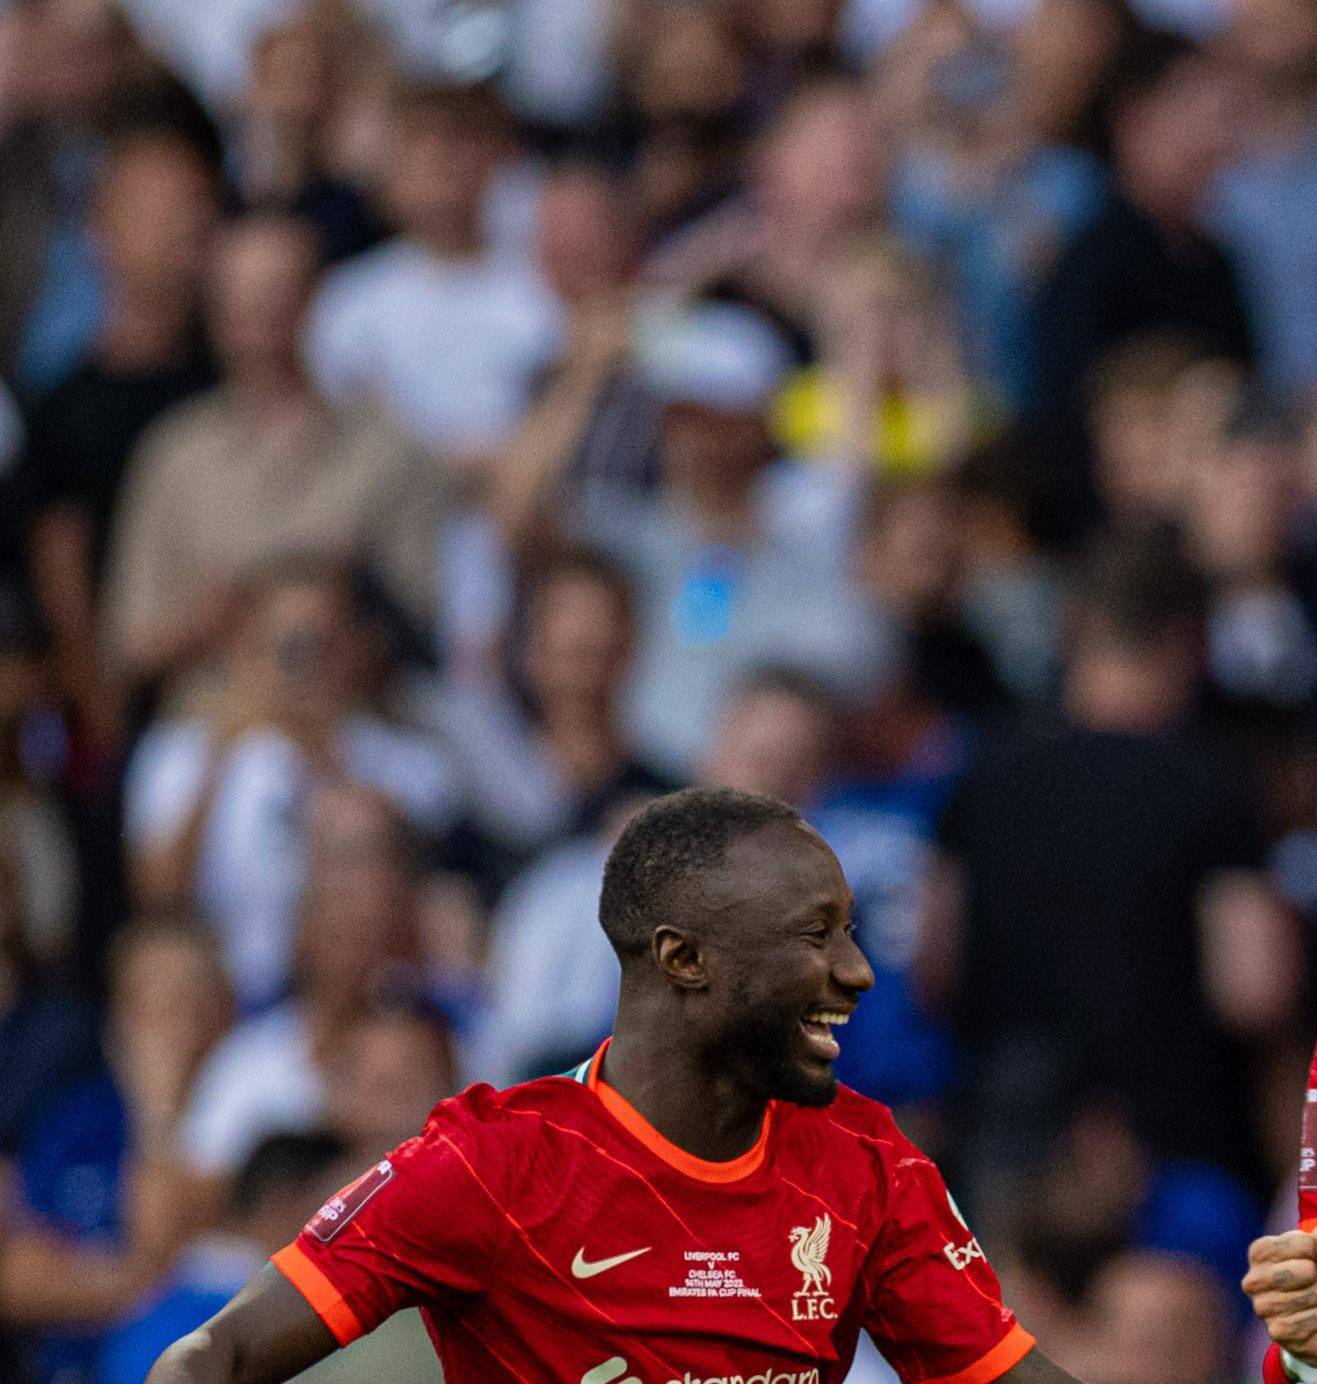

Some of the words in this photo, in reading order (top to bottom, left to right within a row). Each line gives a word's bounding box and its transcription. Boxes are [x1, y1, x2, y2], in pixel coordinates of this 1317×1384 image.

[684, 1251, 726, 1261] LIVERPOOL
[728, 1252, 740, 1261] FC
[689, 1270, 723, 1279] CHELSEA
[725, 1270, 736, 1279] FC
[705, 1279, 723, 1288] MAY
[669, 1287, 707, 1297] EMIRATES
[707, 1287, 718, 1297] FA
[719, 1287, 736, 1297] CUP
